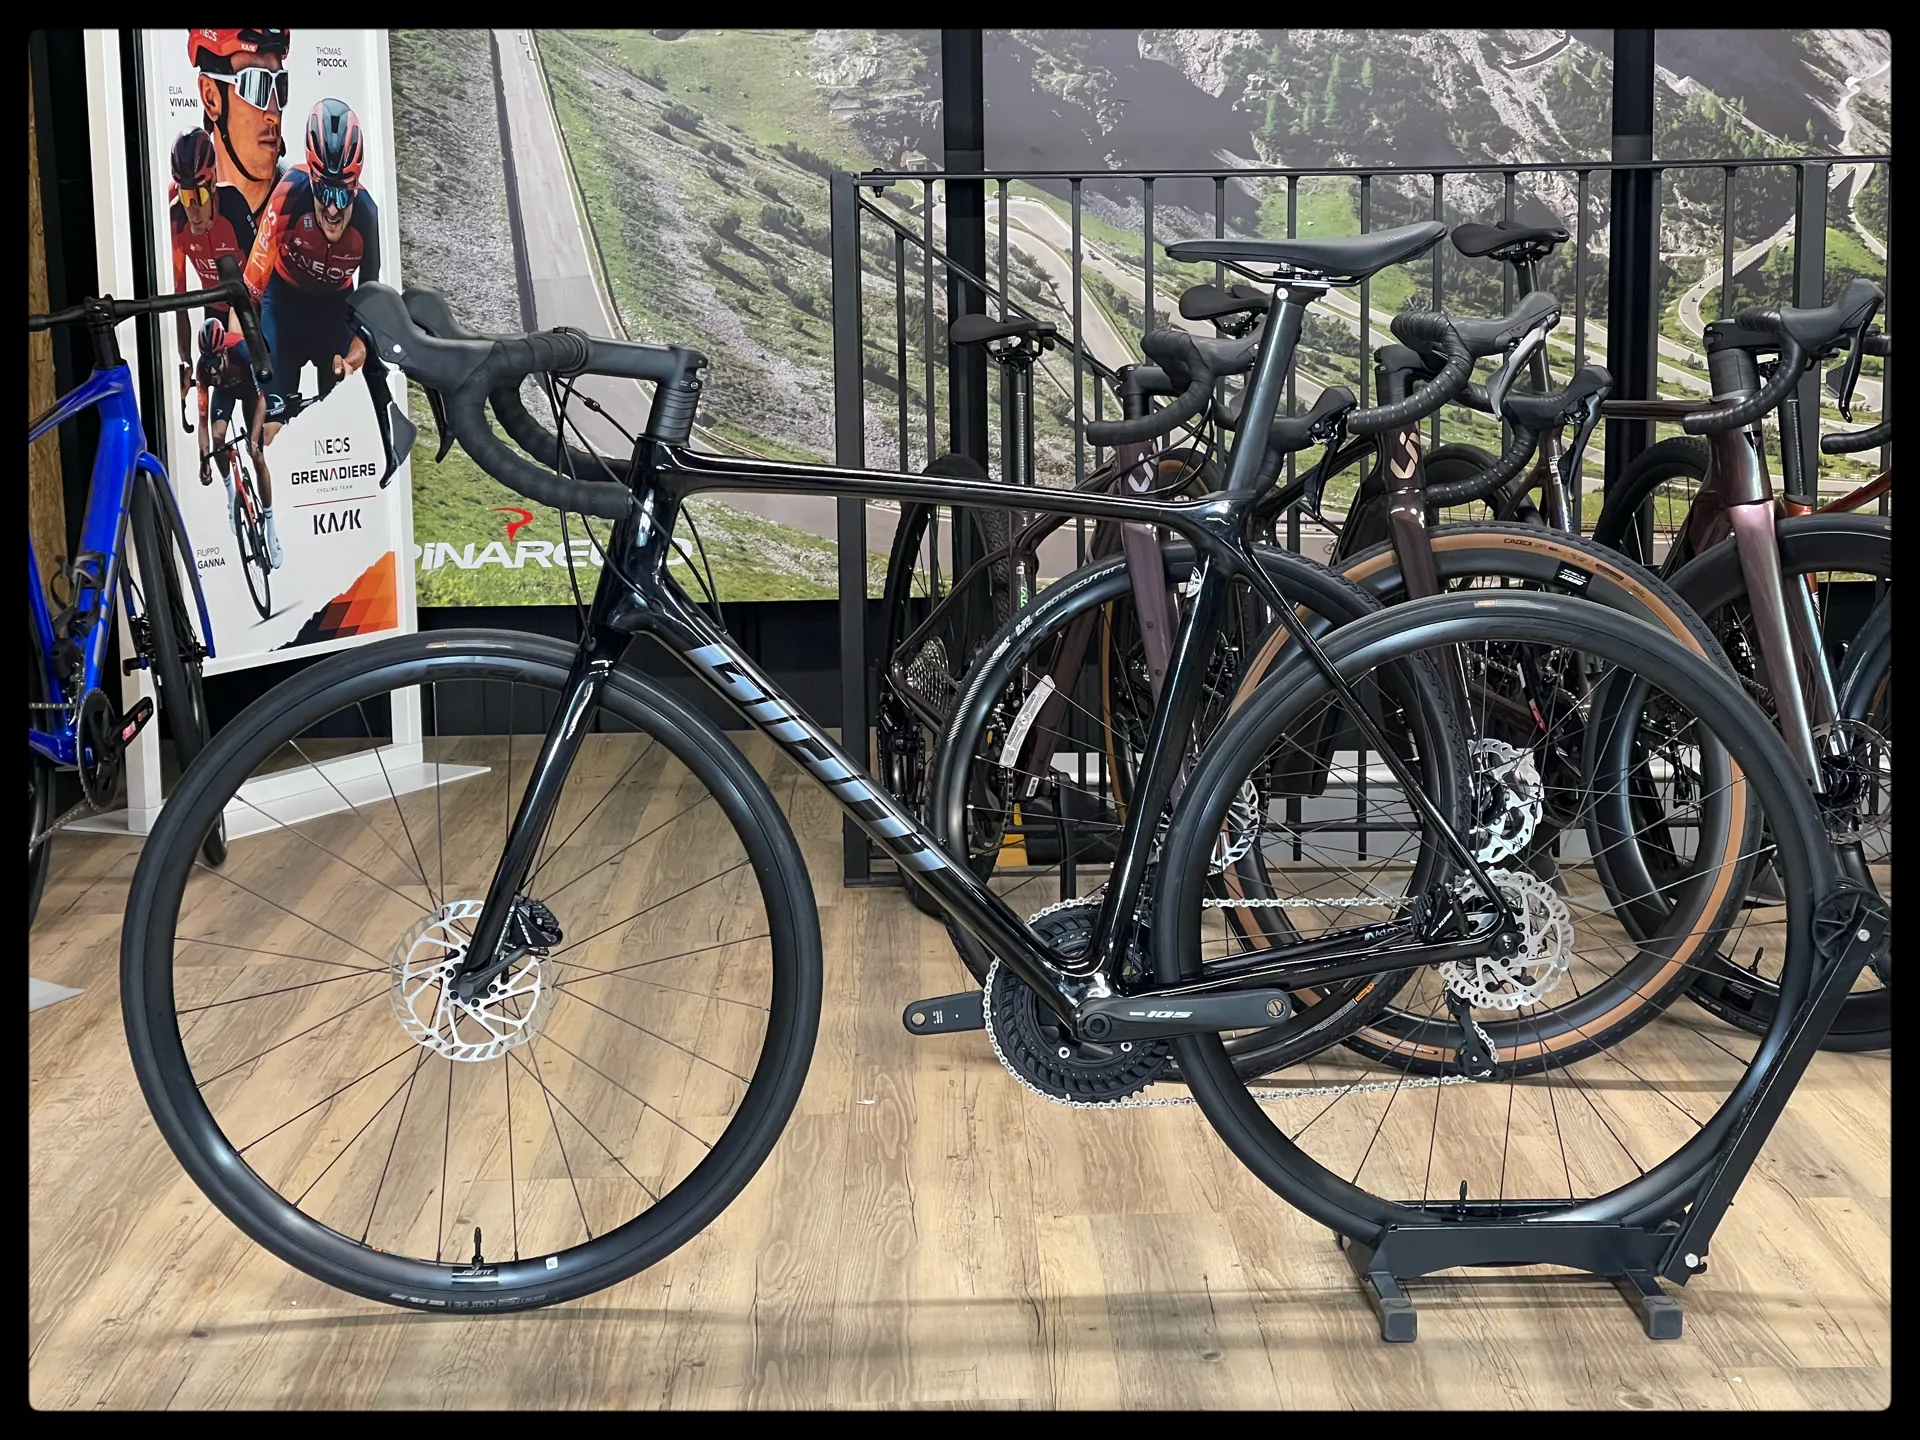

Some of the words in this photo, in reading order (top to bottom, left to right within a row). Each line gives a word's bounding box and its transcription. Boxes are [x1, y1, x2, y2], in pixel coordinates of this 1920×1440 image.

[316, 46, 342, 56] THOMAS
[316, 57, 348, 69] PIDCOCK
[168, 85, 183, 96] ELIA
[169, 97, 198, 109] VIVIANI
[313, 436, 351, 457] INEOS
[291, 462, 376, 486] GRENADIERS
[316, 486, 338, 494] CYCLING
[338, 484, 354, 492] TEAM
[313, 508, 362, 536] KASK
[196, 546, 220, 558] FILIPPO
[197, 557, 226, 570] GANNA
[1035, 571, 1103, 617] CROSSCUT
